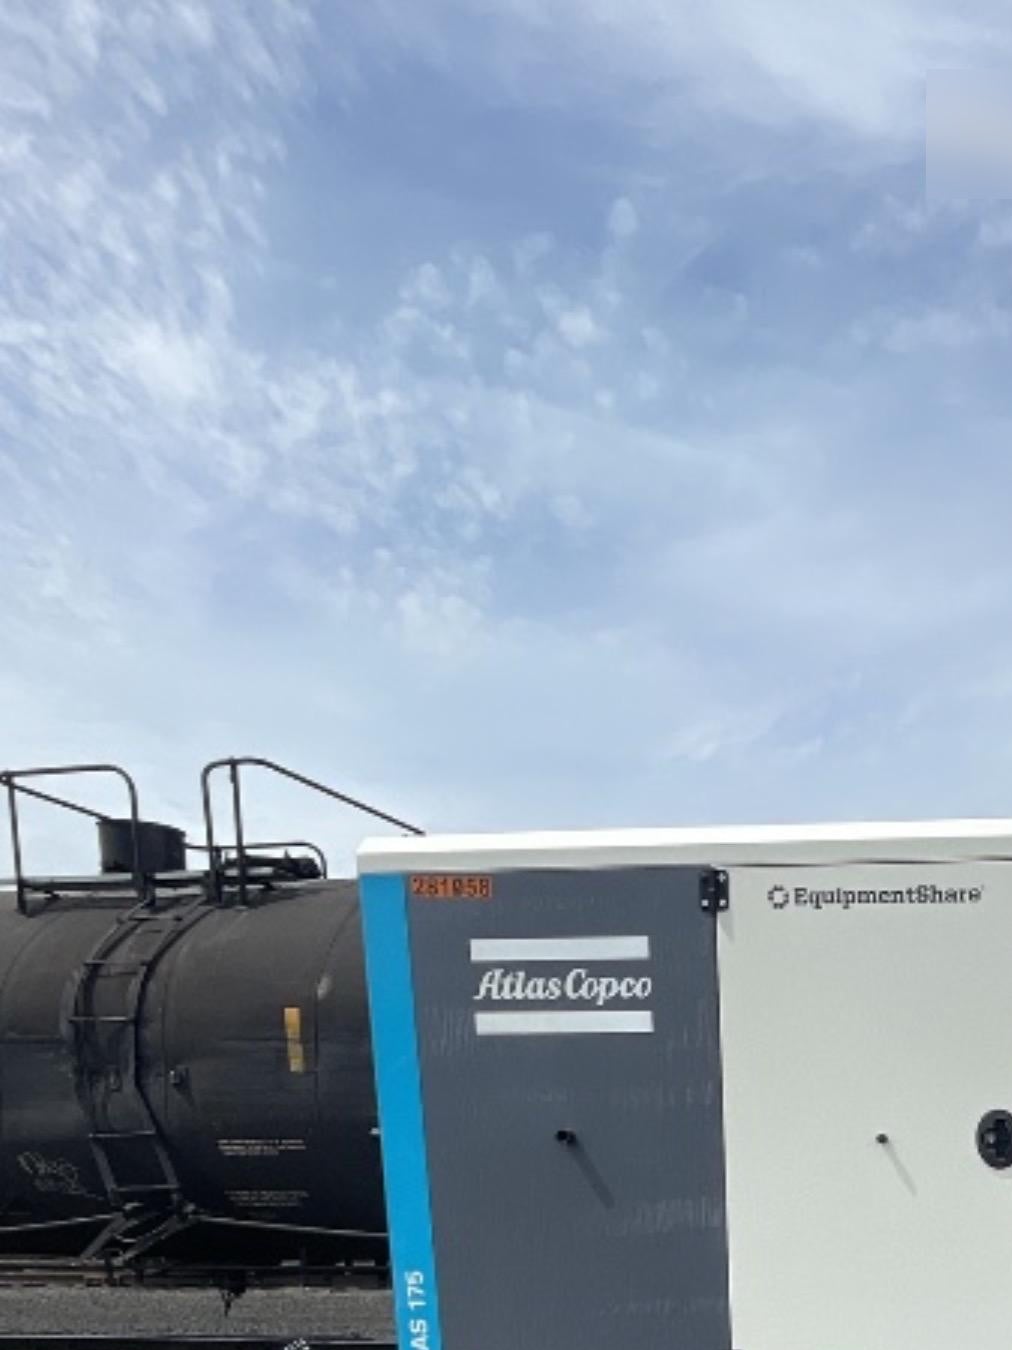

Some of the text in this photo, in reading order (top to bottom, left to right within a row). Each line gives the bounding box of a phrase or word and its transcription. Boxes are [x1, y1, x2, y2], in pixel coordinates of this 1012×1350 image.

[793, 884, 982, 910] EquipmentShare
[473, 968, 653, 1006] Atlas Copco
[404, 1270, 427, 1311] 175
